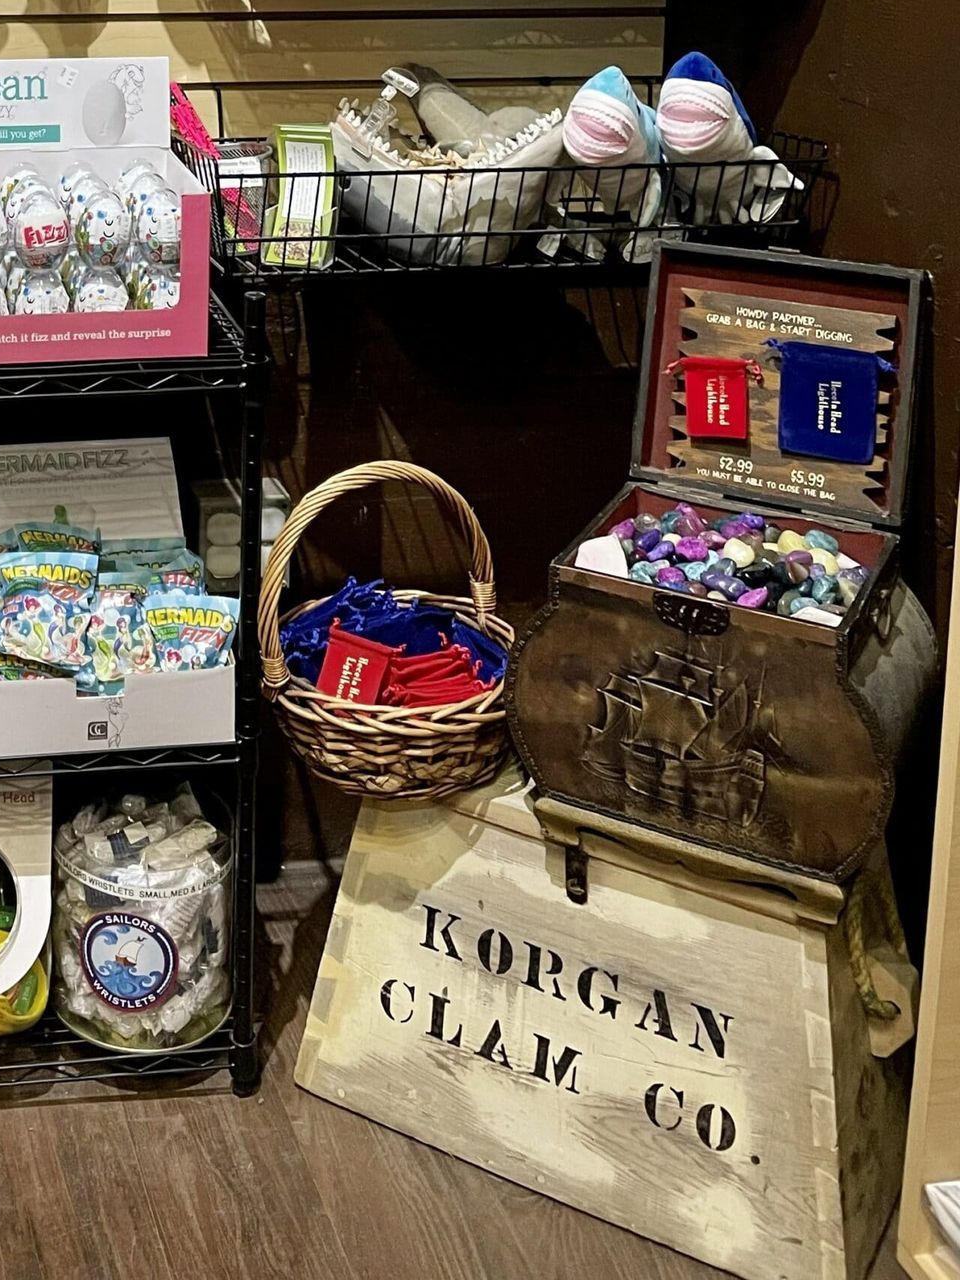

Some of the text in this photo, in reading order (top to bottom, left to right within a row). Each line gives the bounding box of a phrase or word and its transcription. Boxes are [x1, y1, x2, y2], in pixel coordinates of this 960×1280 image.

[10, 131, 27, 141] you
[28, 128, 46, 141] get?
[736, 307, 769, 320] HOWDY
[21, 333, 29, 343] it
[31, 332, 49, 343] fizz
[50, 331, 70, 341] and
[73, 330, 106, 340] reveal
[108, 329, 126, 338] the
[128, 327, 171, 339] surprise
[706, 313, 853, 343] GRAB A BAG & START DIGGING
[719, 456, 754, 474] $2.99
[696, 467, 836, 501] YOU MUST BE ABLE TO CLOSE THE BAG
[790, 469, 825, 488] $5.99
[1, 564, 92, 590] MERMAIDS
[2, 791, 35, 804] Head
[89, 876, 135, 897] WRISTLETS
[105, 915, 156, 933] SAILORS
[419, 904, 734, 1059] KORGAN
[93, 979, 156, 1009] WRISTLETS
[380, 979, 583, 1094] CLAM
